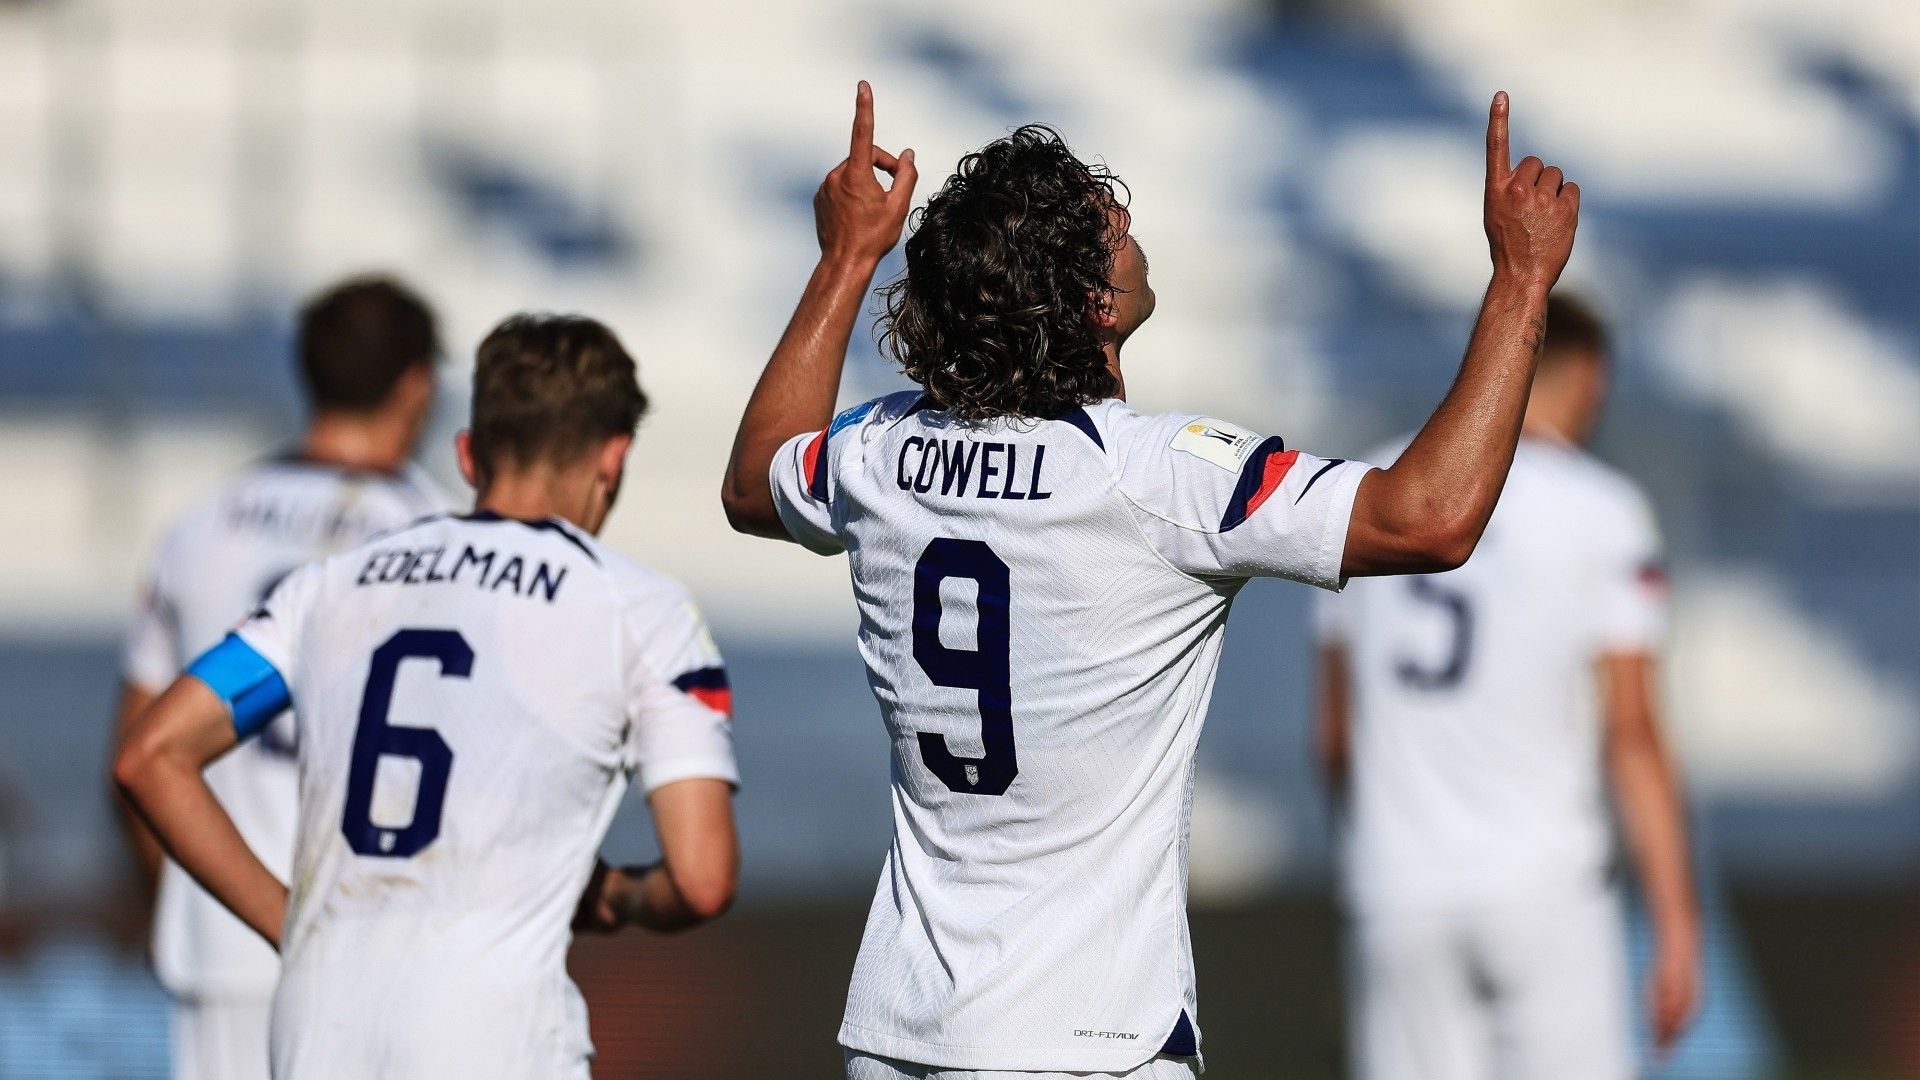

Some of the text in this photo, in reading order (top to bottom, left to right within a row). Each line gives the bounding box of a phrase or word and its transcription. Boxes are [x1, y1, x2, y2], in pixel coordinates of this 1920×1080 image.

[896, 435, 1053, 501] COWELL
[356, 545, 568, 603] EDELMAN
[911, 537, 1018, 797] 9
[341, 629, 475, 858] 6
